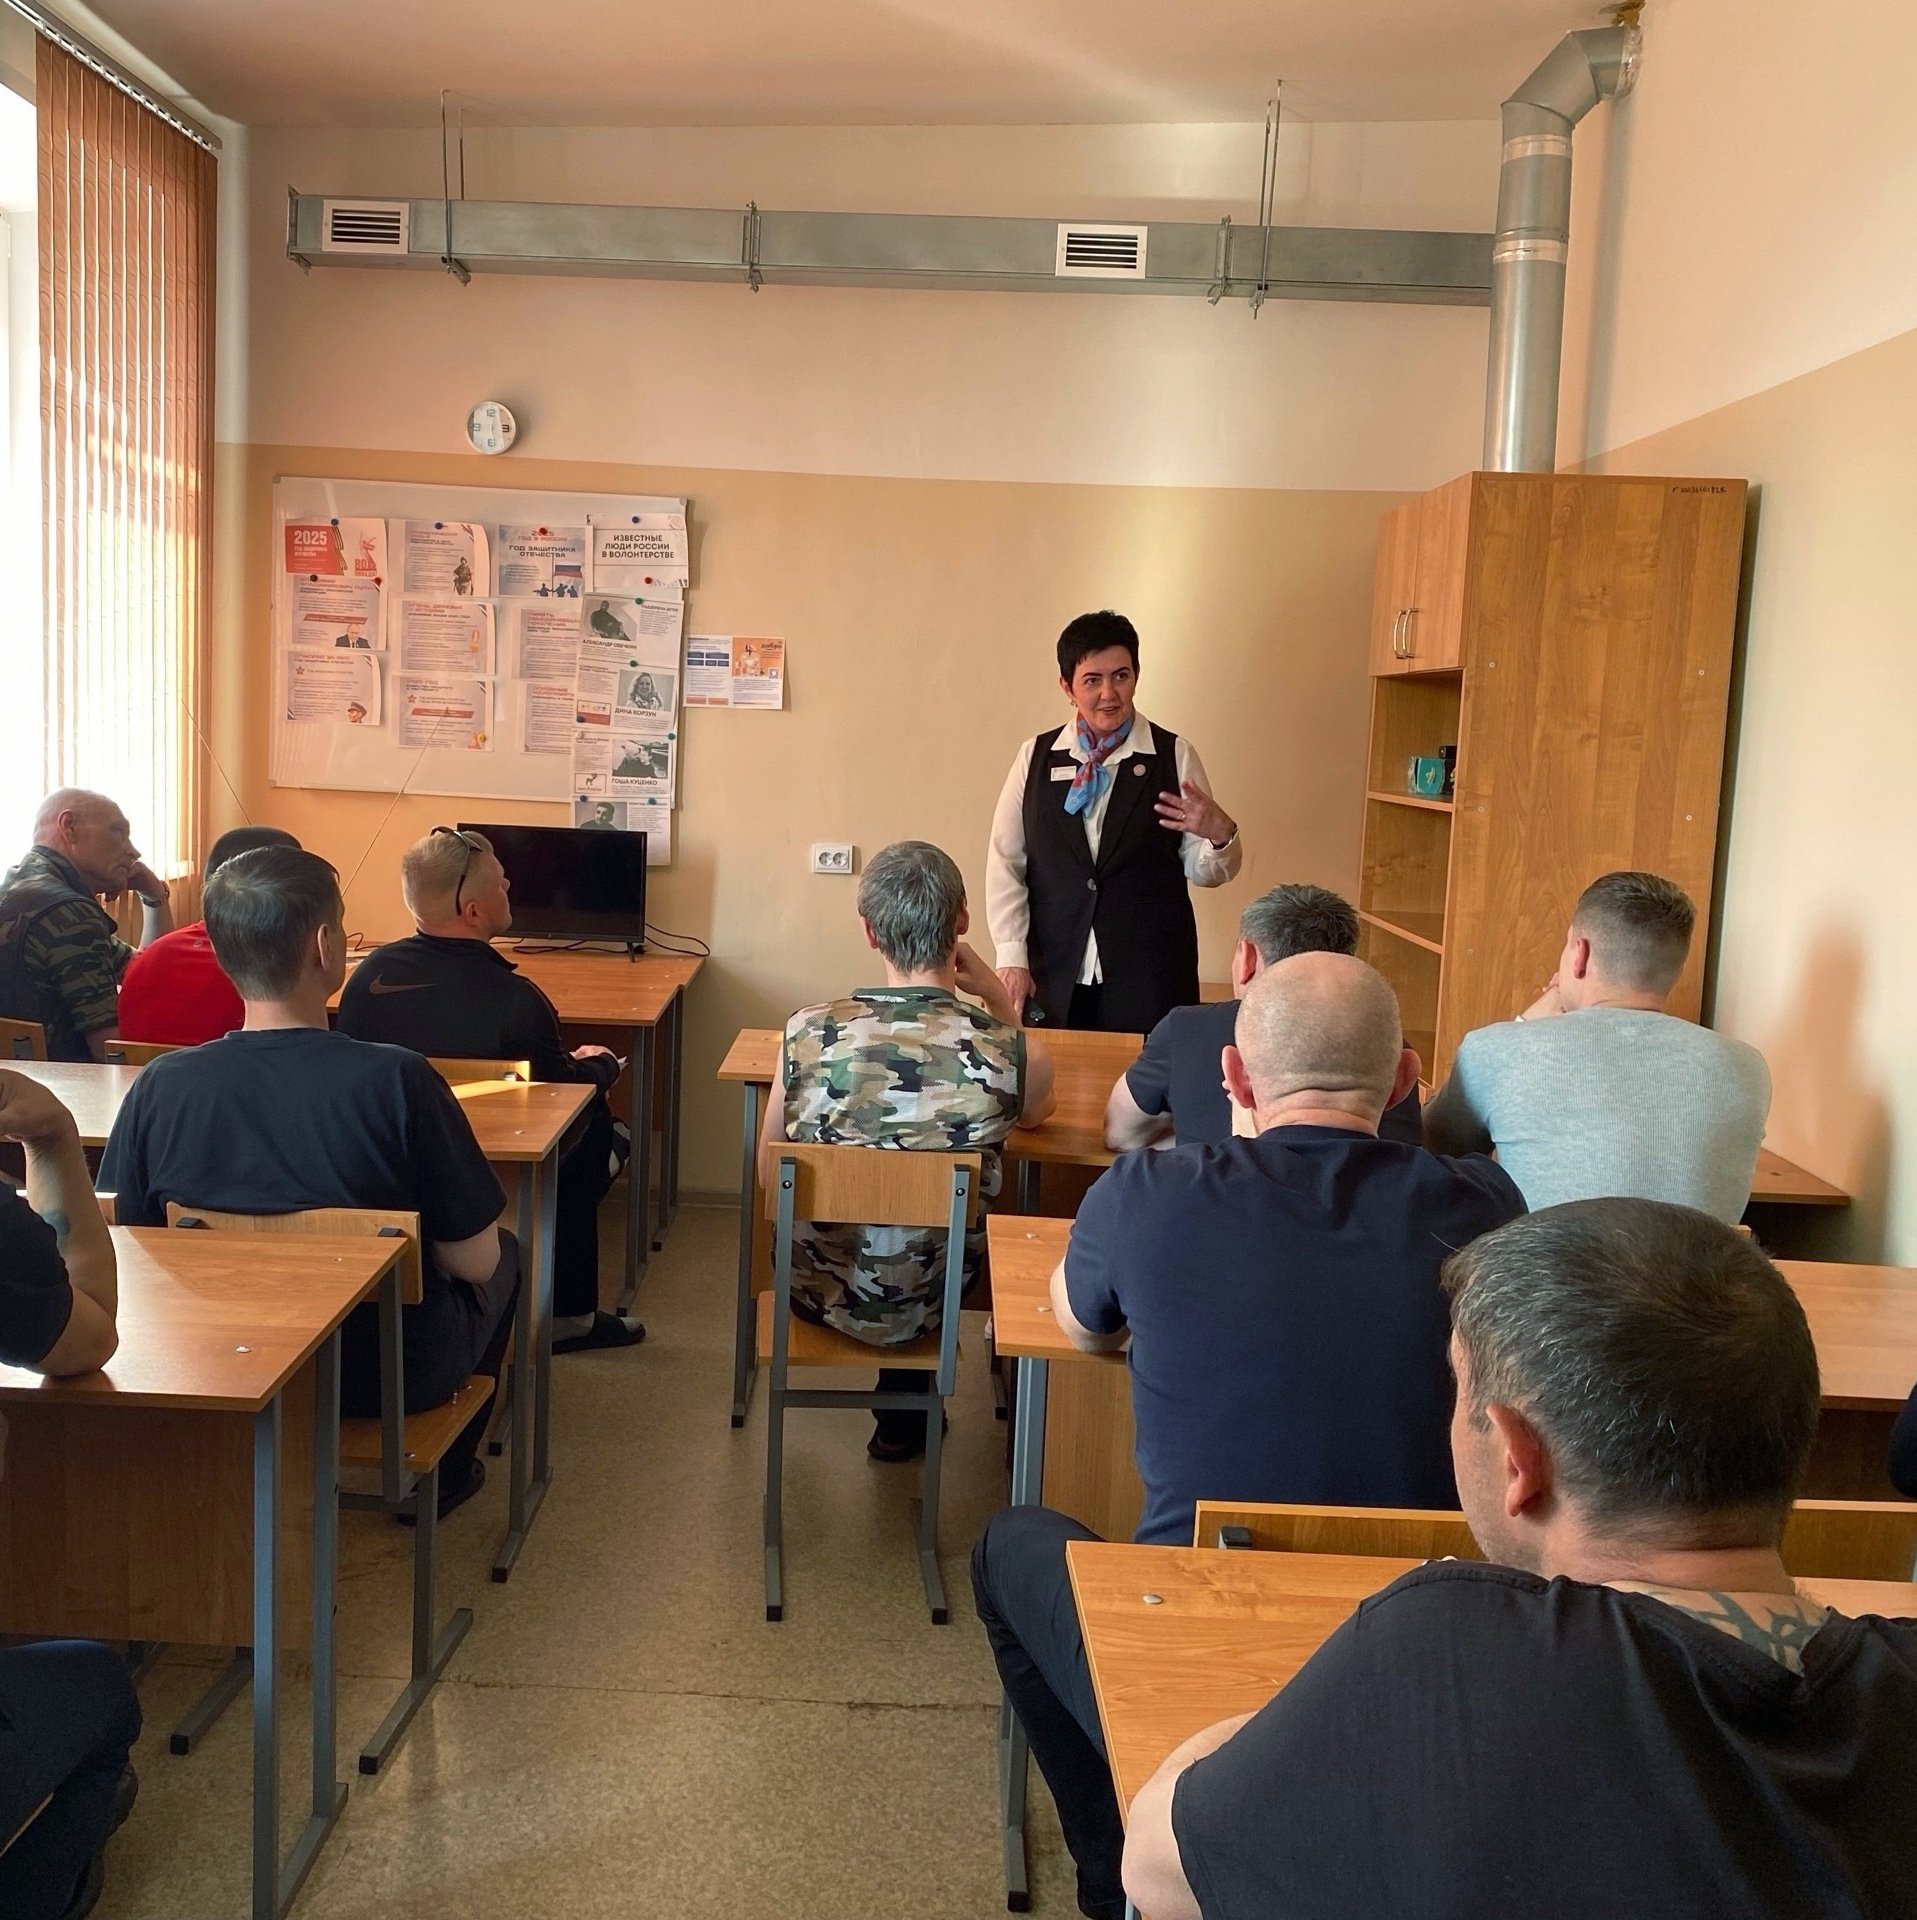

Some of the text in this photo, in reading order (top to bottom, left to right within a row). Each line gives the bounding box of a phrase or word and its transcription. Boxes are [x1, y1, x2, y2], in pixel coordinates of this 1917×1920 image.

[502, 424, 510, 432] 3
[294, 530, 328, 545] 2025
[613, 534, 662, 542] ИЗВЕСТНЫЕ
[582, 639, 611, 647] АЛЕКСАНДР
[614, 707, 657, 717] ДИНА КОРЗУН
